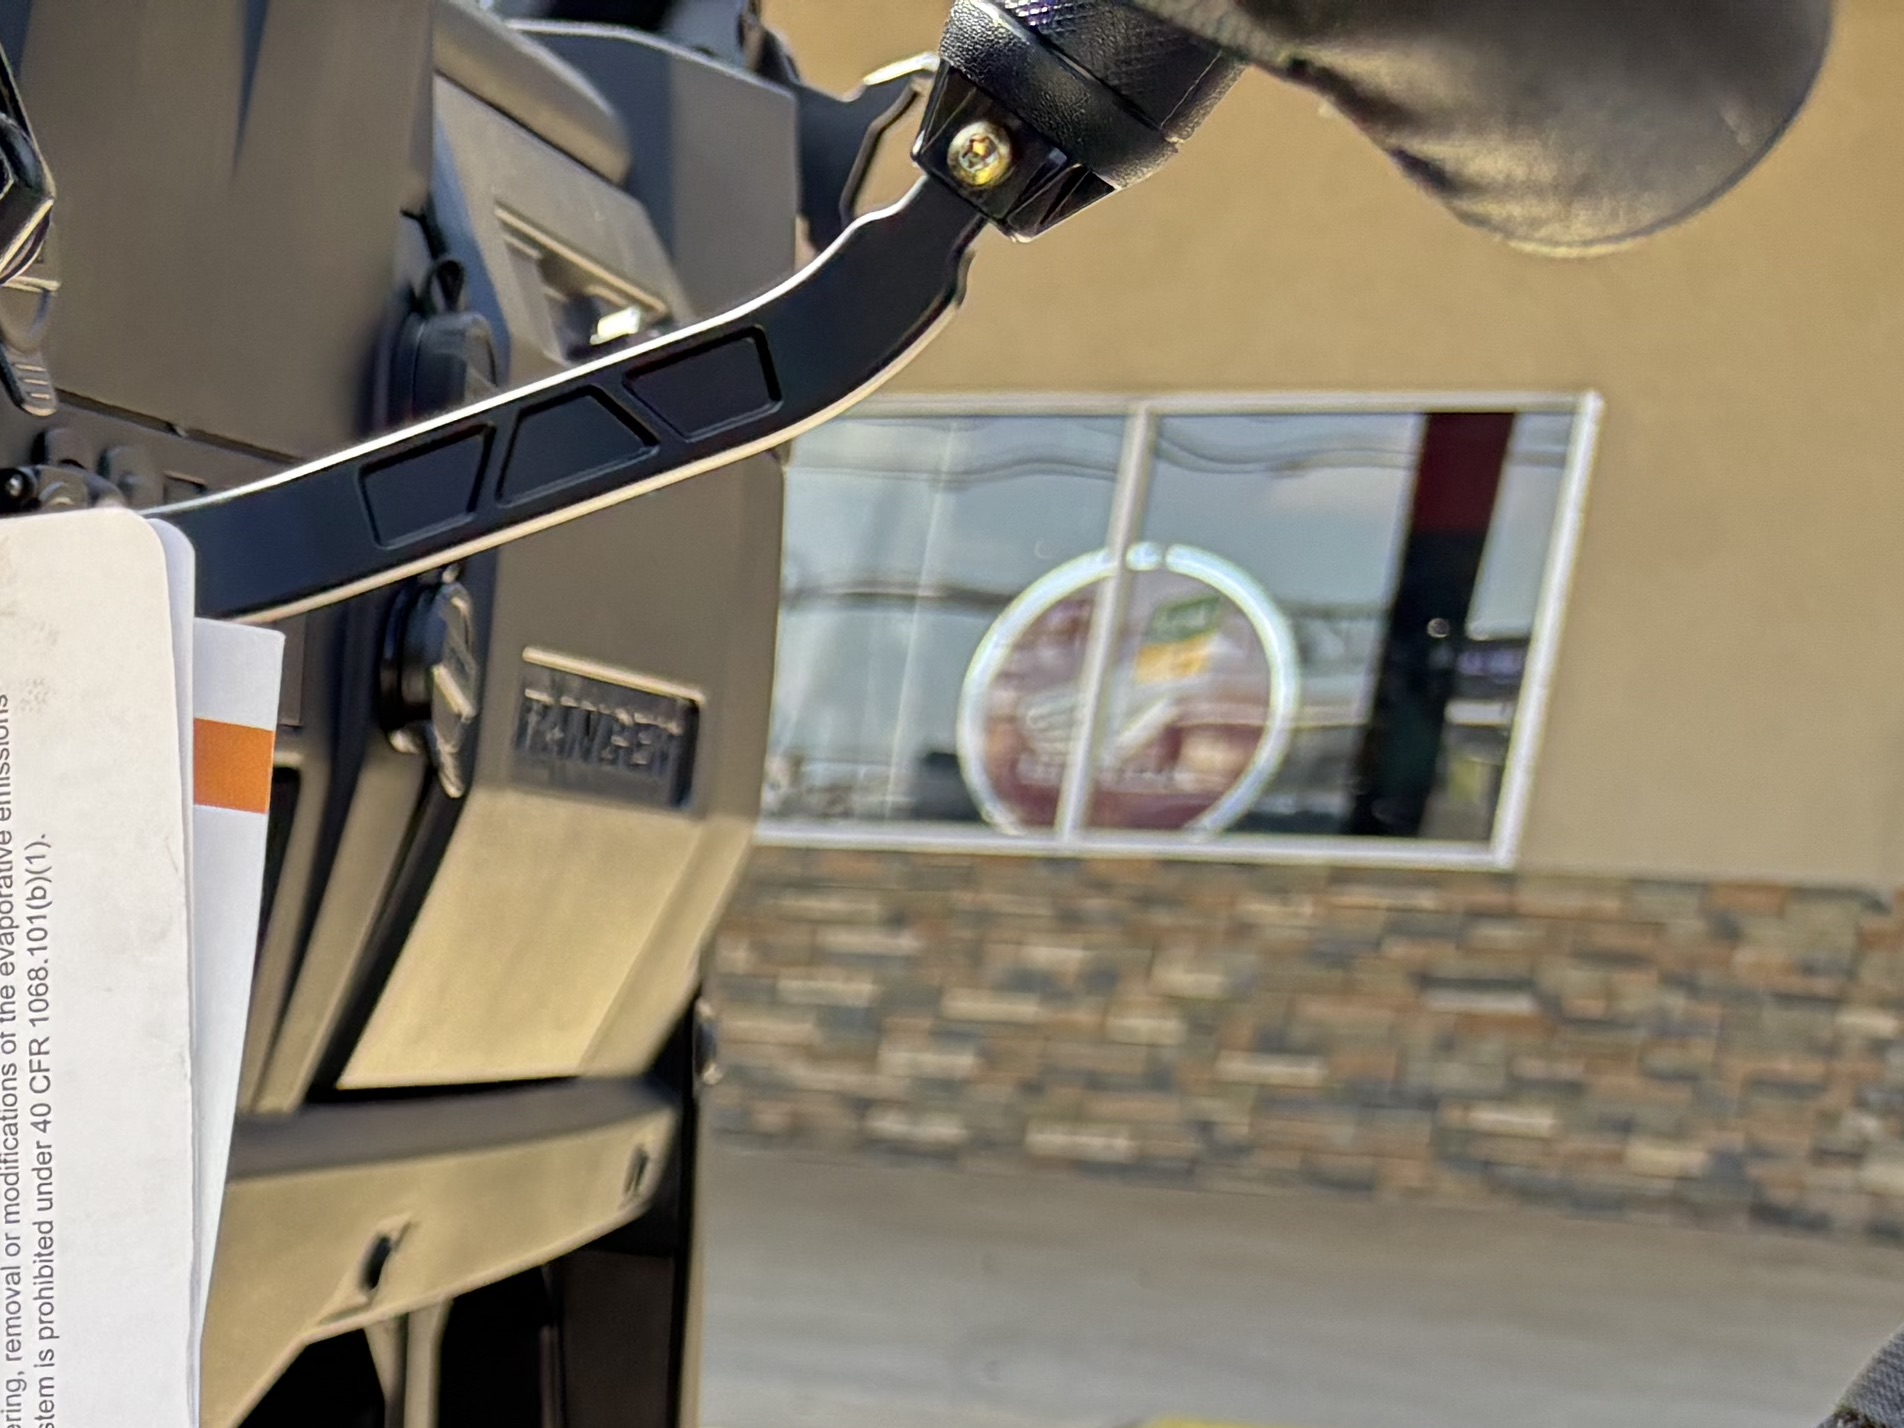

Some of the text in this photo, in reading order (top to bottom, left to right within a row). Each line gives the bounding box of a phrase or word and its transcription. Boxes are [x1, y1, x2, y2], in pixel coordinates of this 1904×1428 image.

[23, 833, 53, 1028] 1068.101(b)(1).
[27, 1036, 51, 1094] CFR
[29, 1102, 52, 1134] 40
[30, 1139, 54, 1212] under
[4, 1231, 21, 1257] or
[31, 1219, 60, 1341] prohibited
[0, 1265, 22, 1362] removal
[33, 1348, 55, 1368] is
